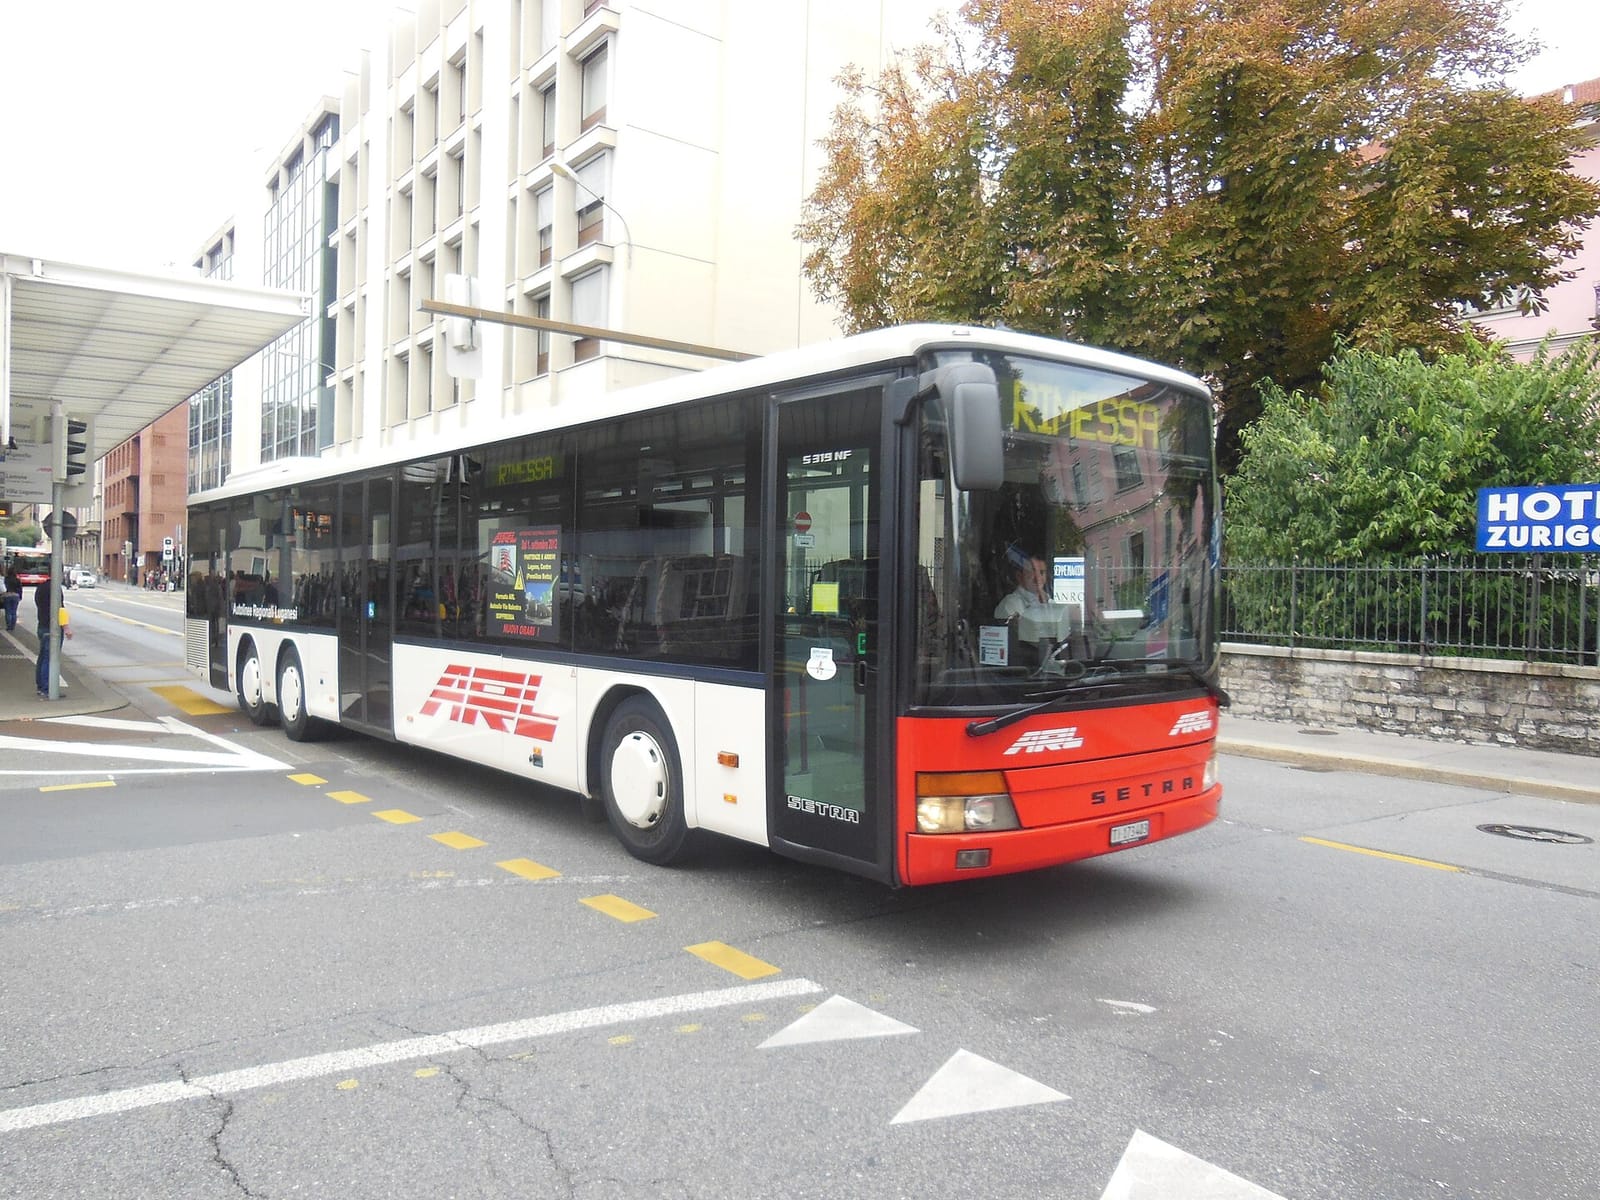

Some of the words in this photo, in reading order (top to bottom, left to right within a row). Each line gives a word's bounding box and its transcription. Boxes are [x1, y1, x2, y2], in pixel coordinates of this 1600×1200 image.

[1013, 379, 1158, 448] RIMESSA
[498, 456, 553, 486] RIMESSA
[802, 455, 811, 465] S
[834, 450, 852, 461] NF
[1487, 491, 1600, 521] HOT
[419, 664, 560, 742] ARL
[1003, 727, 1085, 756] ARL
[1091, 777, 1194, 805] SETRA
[787, 795, 860, 823] SETRA
